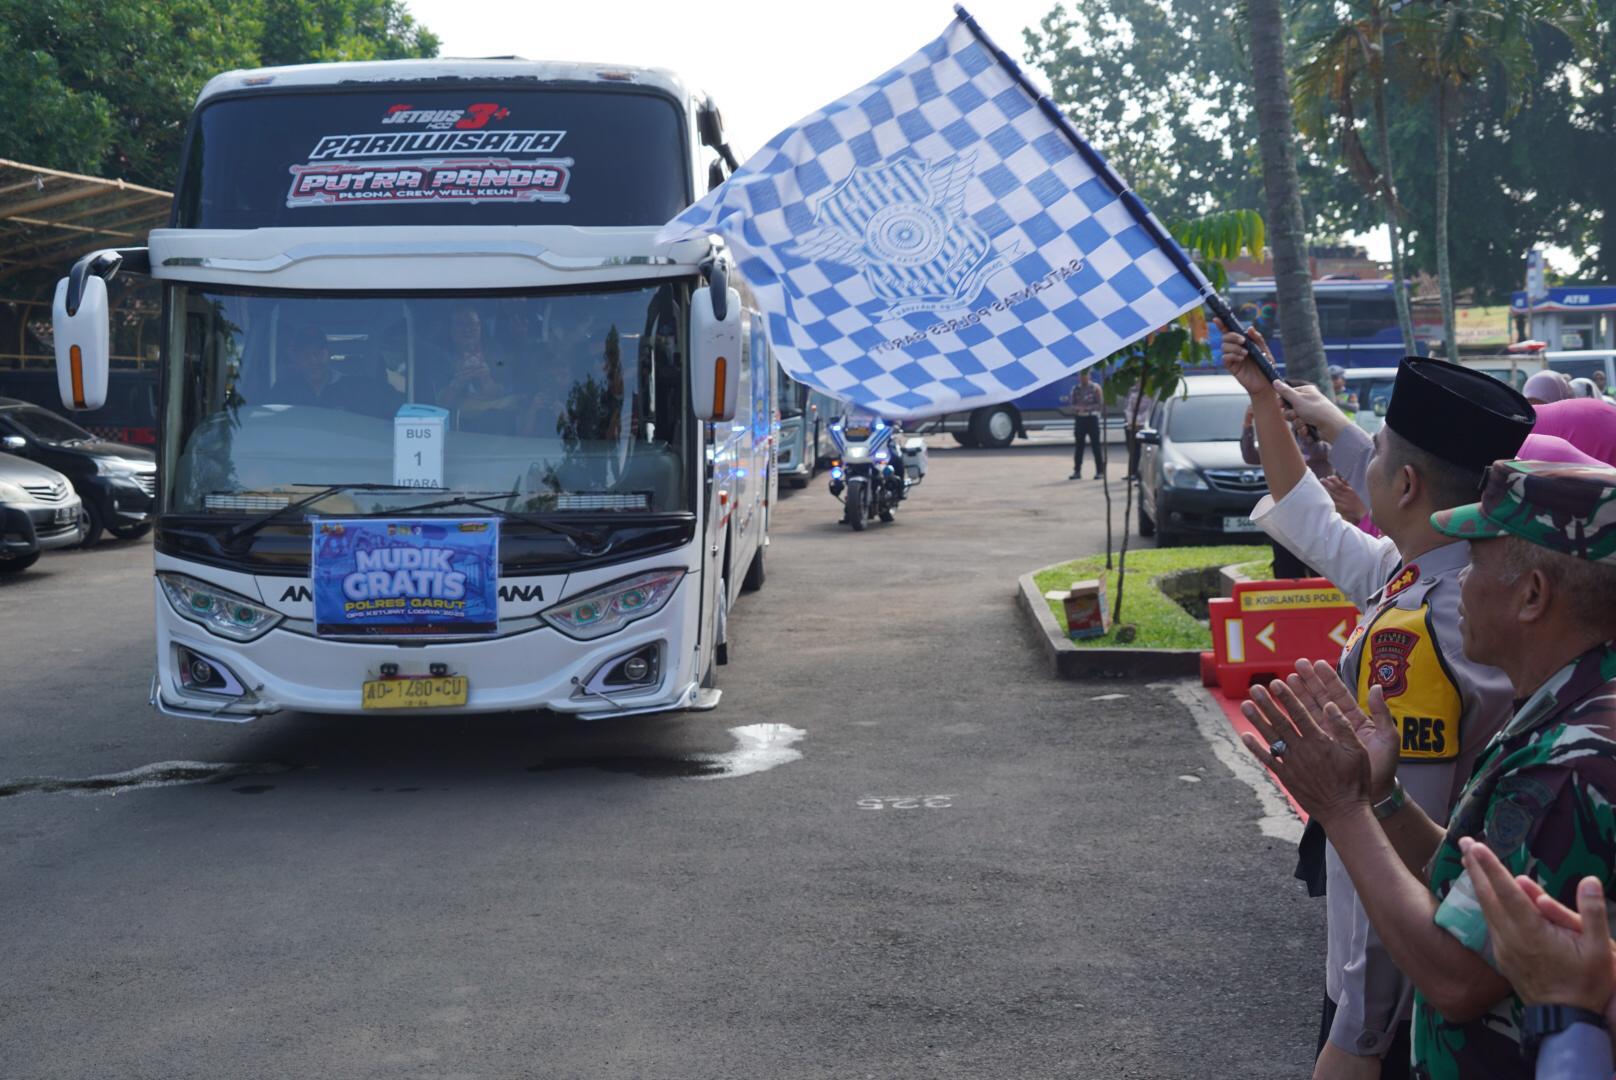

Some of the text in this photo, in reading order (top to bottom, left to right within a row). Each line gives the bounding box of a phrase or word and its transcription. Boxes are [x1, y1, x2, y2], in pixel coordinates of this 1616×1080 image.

[382, 108, 464, 124] JETBUS
[309, 130, 567, 159] PARIWISATA
[299, 168, 559, 192] PUTRA PANDA
[396, 189, 435, 198] CREW
[477, 187, 514, 196] KEUN
[1563, 294, 1590, 304] ATM
[406, 428, 432, 439] BUS
[414, 451, 422, 466] 1
[398, 478, 440, 488] UTARA
[355, 548, 454, 573] MUDIK
[343, 571, 467, 599] GRATIS
[345, 599, 465, 611] POLRES GARUT
[1256, 593, 1341, 605] KORLANTAS POLRI
[442, 679, 461, 696] CU
[1402, 716, 1445, 753] RES
